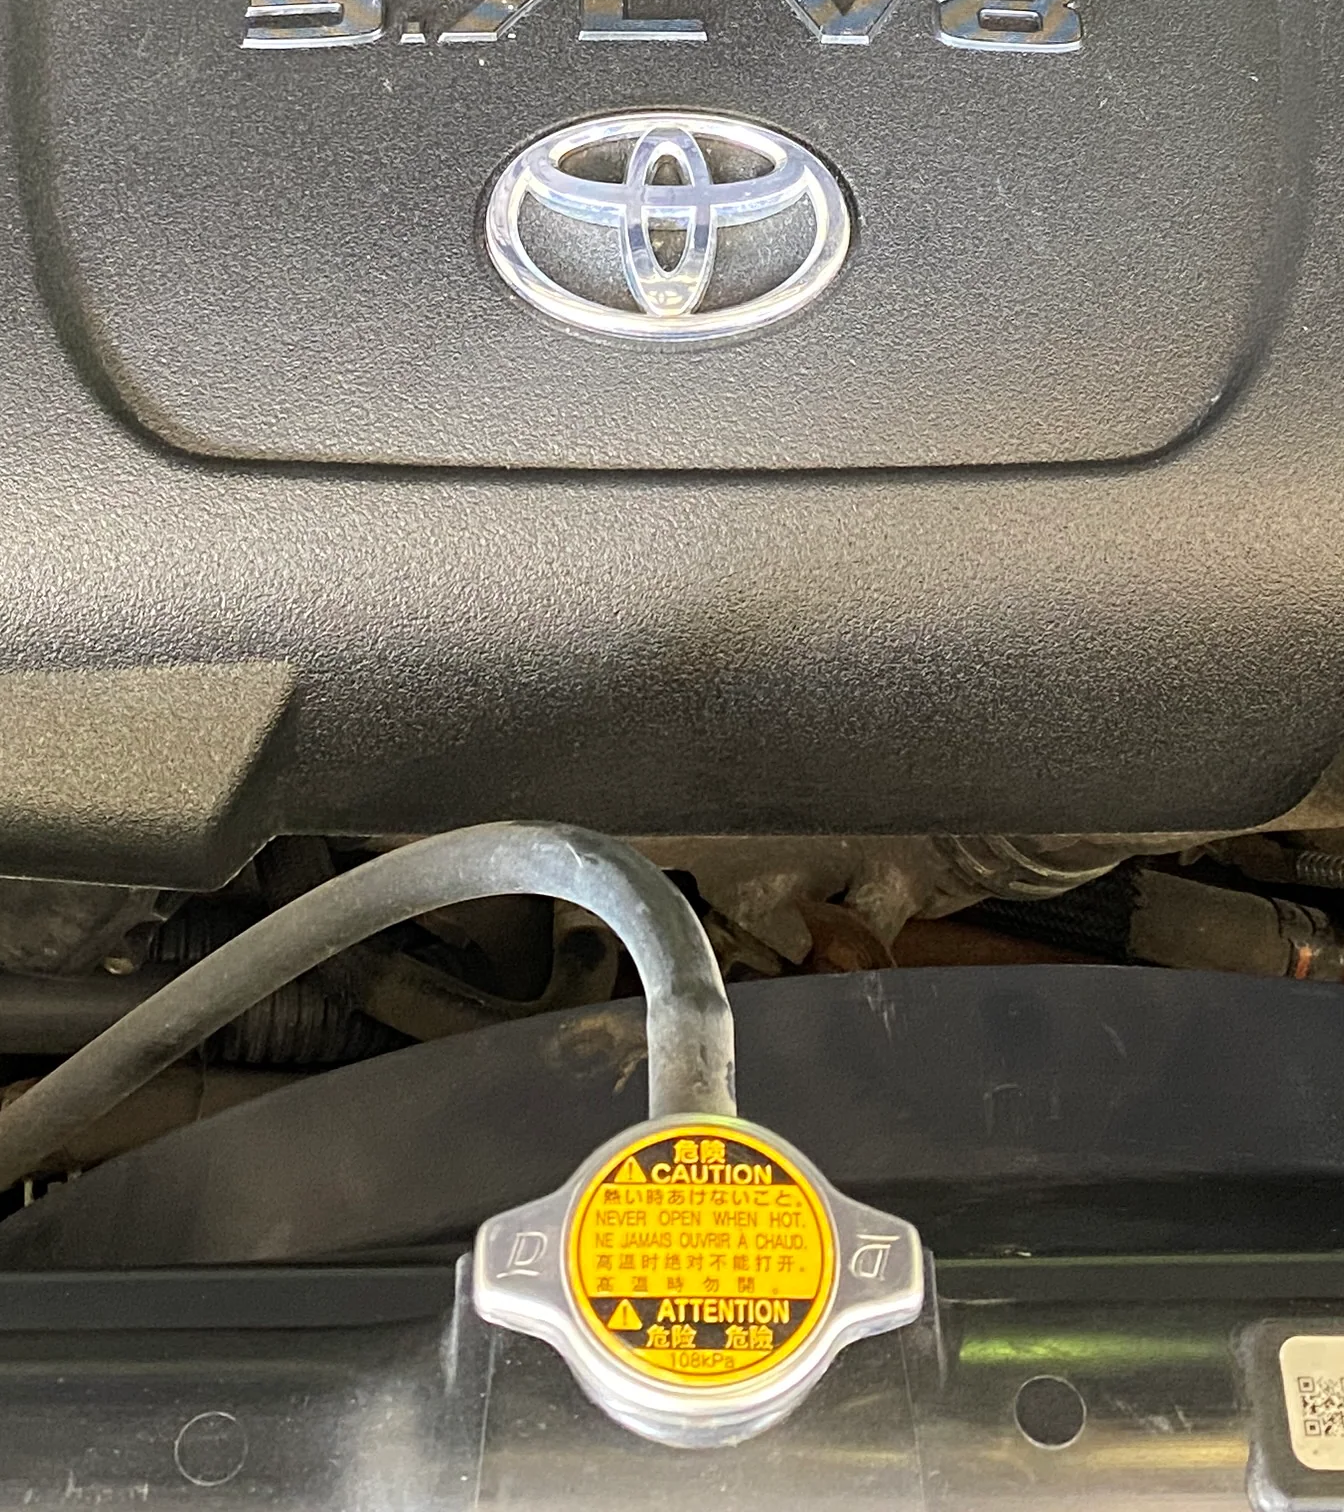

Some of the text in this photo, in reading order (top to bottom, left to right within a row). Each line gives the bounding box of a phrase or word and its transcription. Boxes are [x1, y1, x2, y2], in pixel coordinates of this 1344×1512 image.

[650, 1163, 772, 1185] CAUTION
[596, 1211, 806, 1228] NEVER OPEN WHEN HOT.
[595, 1232, 613, 1249] NE
[620, 1232, 672, 1249] JAMAIS
[679, 1232, 731, 1249] OUVRIR
[755, 1233, 808, 1250] CHAUD.
[656, 1299, 790, 1324] ATTENTION
[669, 1351, 735, 1369] 108kPa
